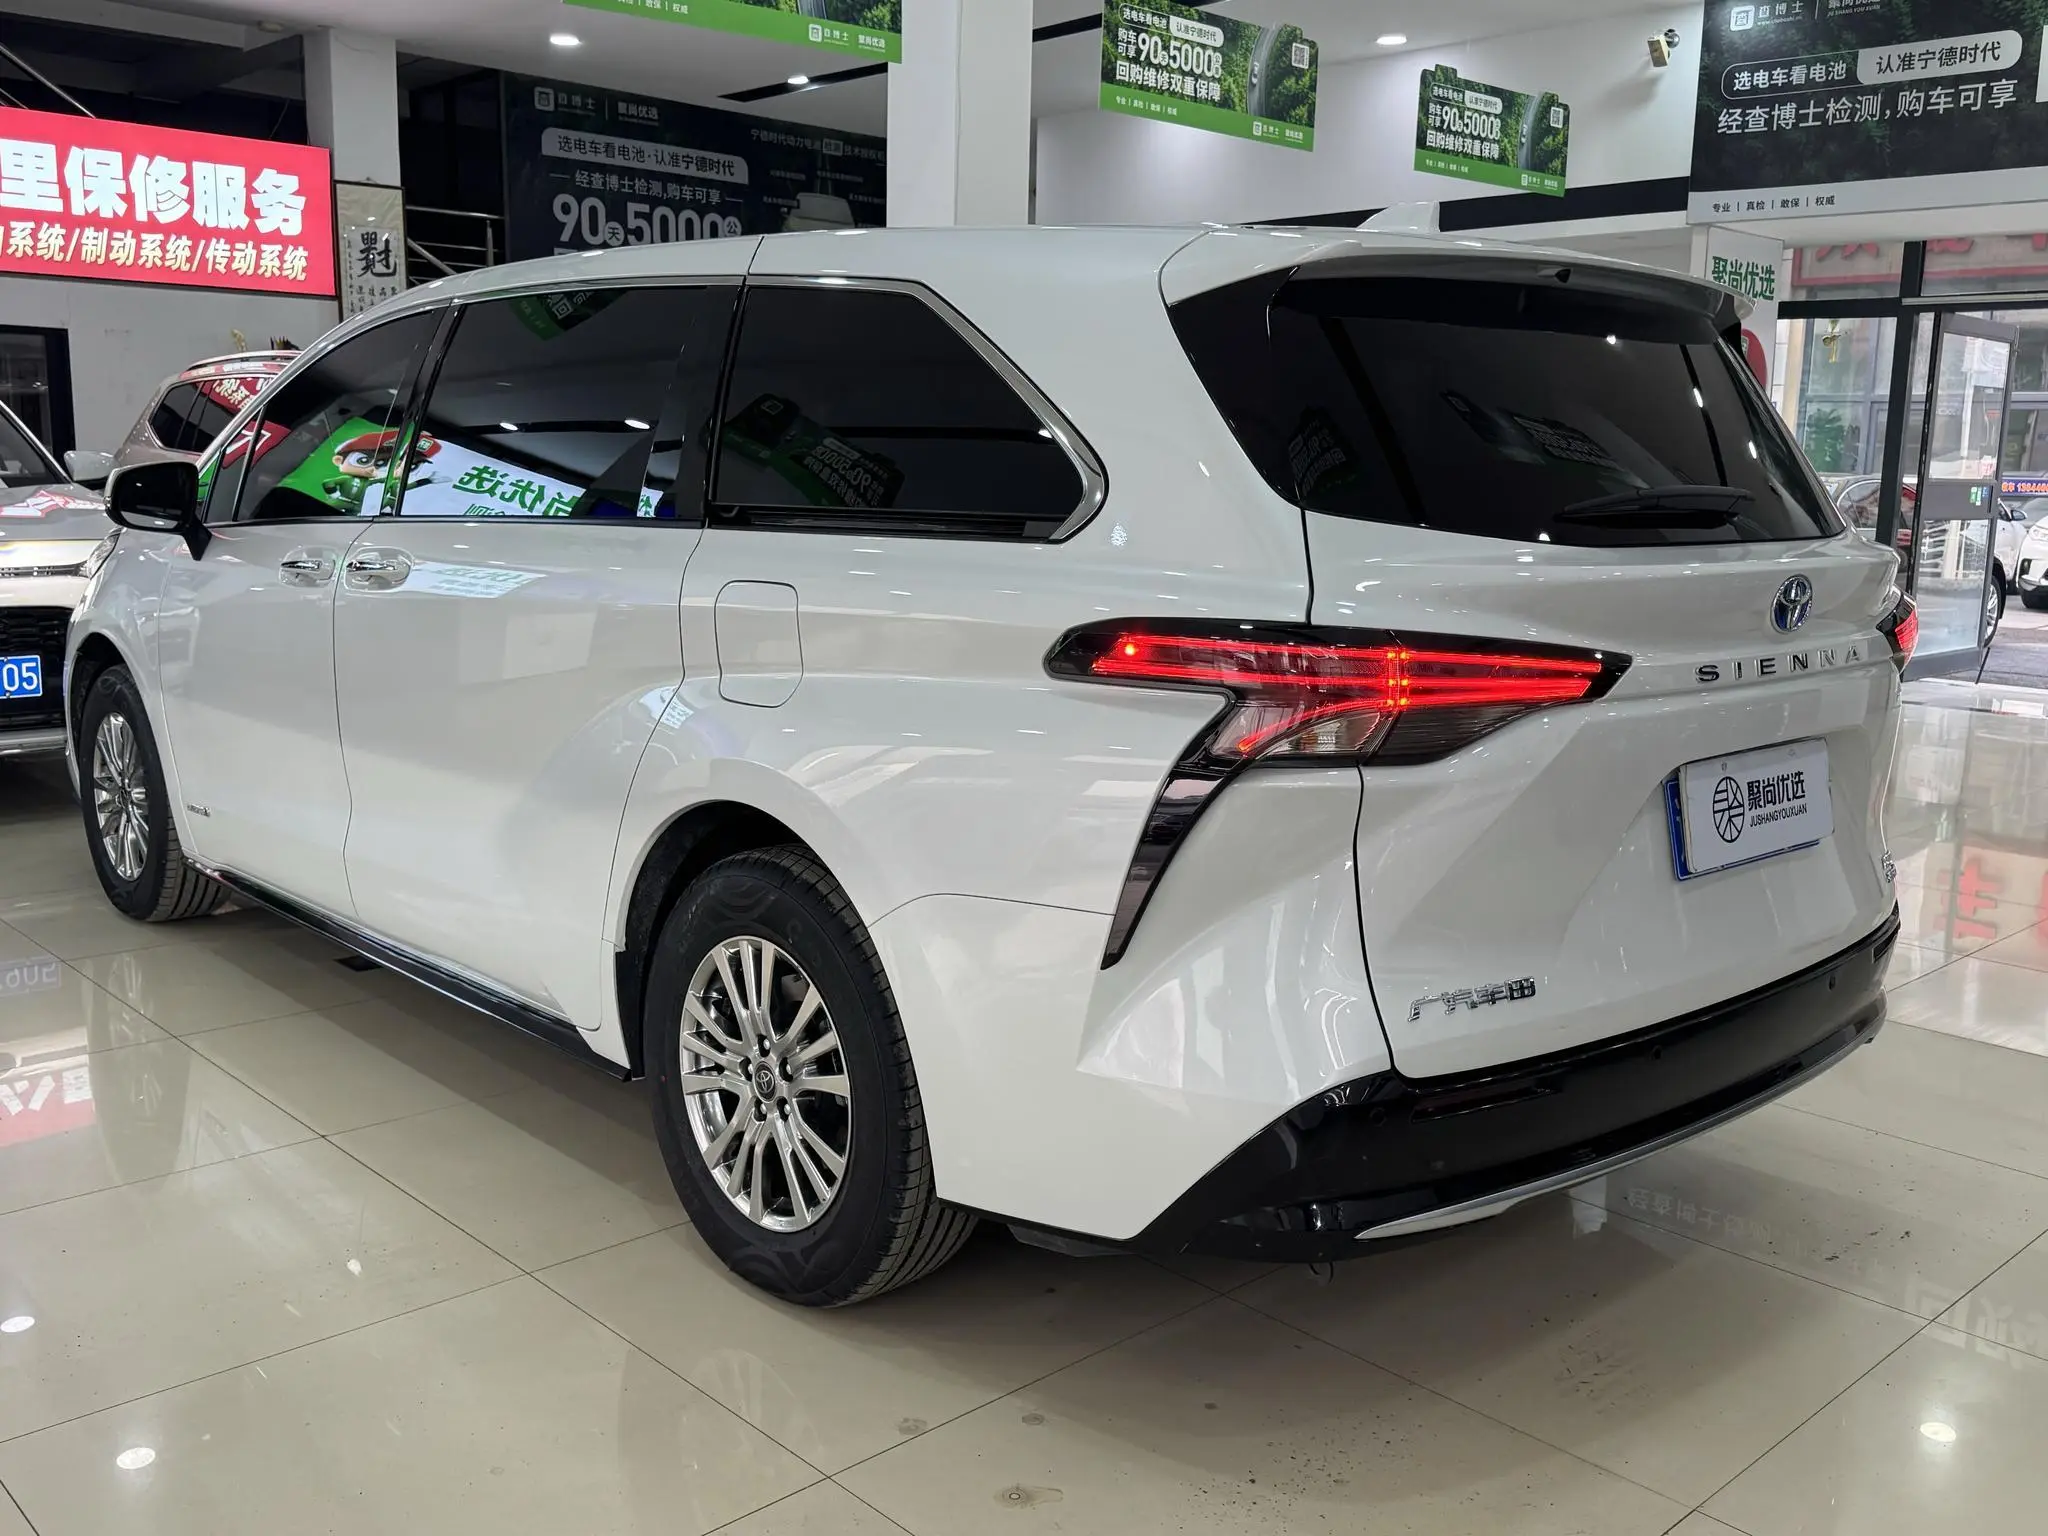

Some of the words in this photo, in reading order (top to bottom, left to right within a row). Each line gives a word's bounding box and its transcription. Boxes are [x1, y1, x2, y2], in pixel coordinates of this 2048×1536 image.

[1116, 60, 1221, 101] 回购维修双重保障
[1733, 60, 1847, 91] 选电车看电池
[1876, 42, 2001, 75] 认准宁德时代
[0, 138, 306, 236] 里保修服务
[1712, 202, 1731, 213] 专业
[1746, 199, 1765, 211] 真检
[1780, 198, 1800, 210] 敢保
[1815, 195, 1835, 207] 权威
[0, 220, 309, 281] 系统/制动系统/传动系统
[1711, 255, 1776, 301] 聚尚优选
[1695, 645, 1864, 683] SIENNA
[1746, 771, 1806, 811] 聚尚优选
[1750, 803, 1807, 828] JUSHANGYOUXUAN
